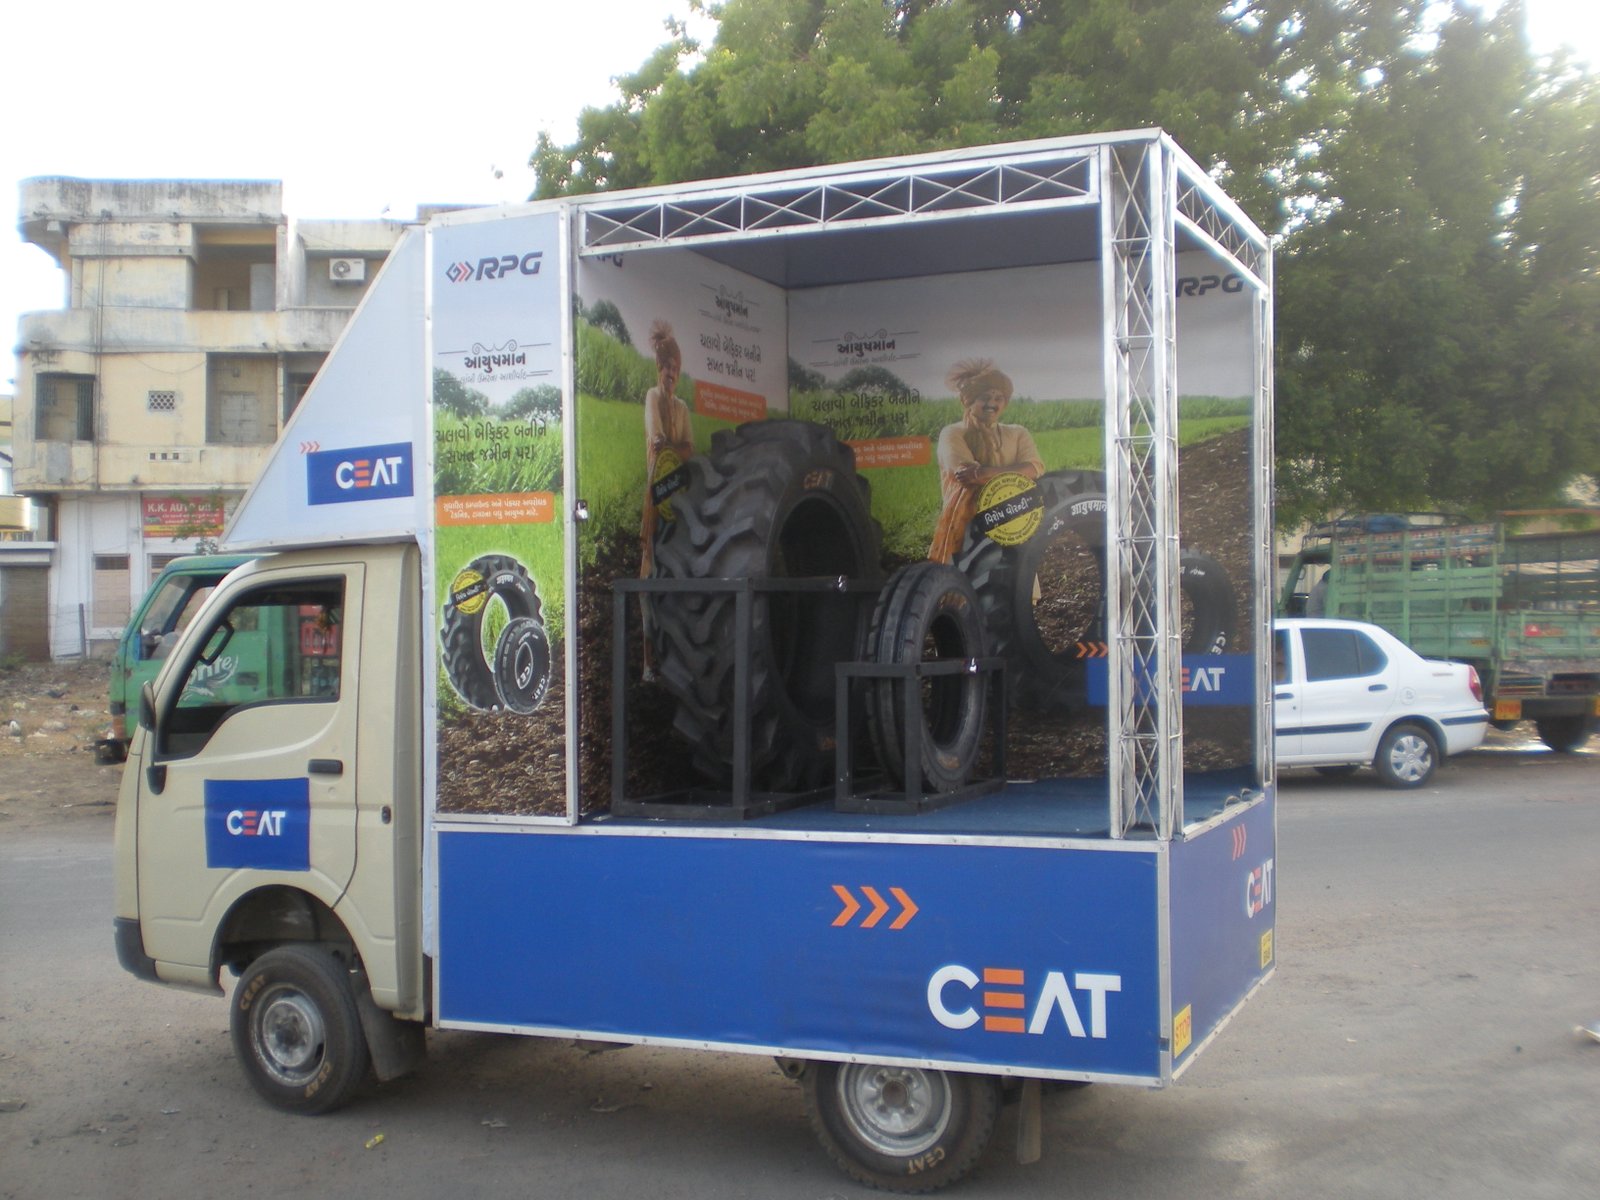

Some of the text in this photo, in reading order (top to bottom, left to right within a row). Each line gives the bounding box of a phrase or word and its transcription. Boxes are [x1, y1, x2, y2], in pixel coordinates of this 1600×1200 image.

[475, 251, 543, 282] RPG
[1176, 273, 1244, 298] RPG
[464, 352, 526, 373] આયુષમાન
[336, 456, 402, 489] CEAT
[226, 809, 286, 836] CEAT
[1246, 858, 1274, 919] CEAT
[927, 964, 1122, 1039] CEAT
[908, 1147, 946, 1175] CEAT
